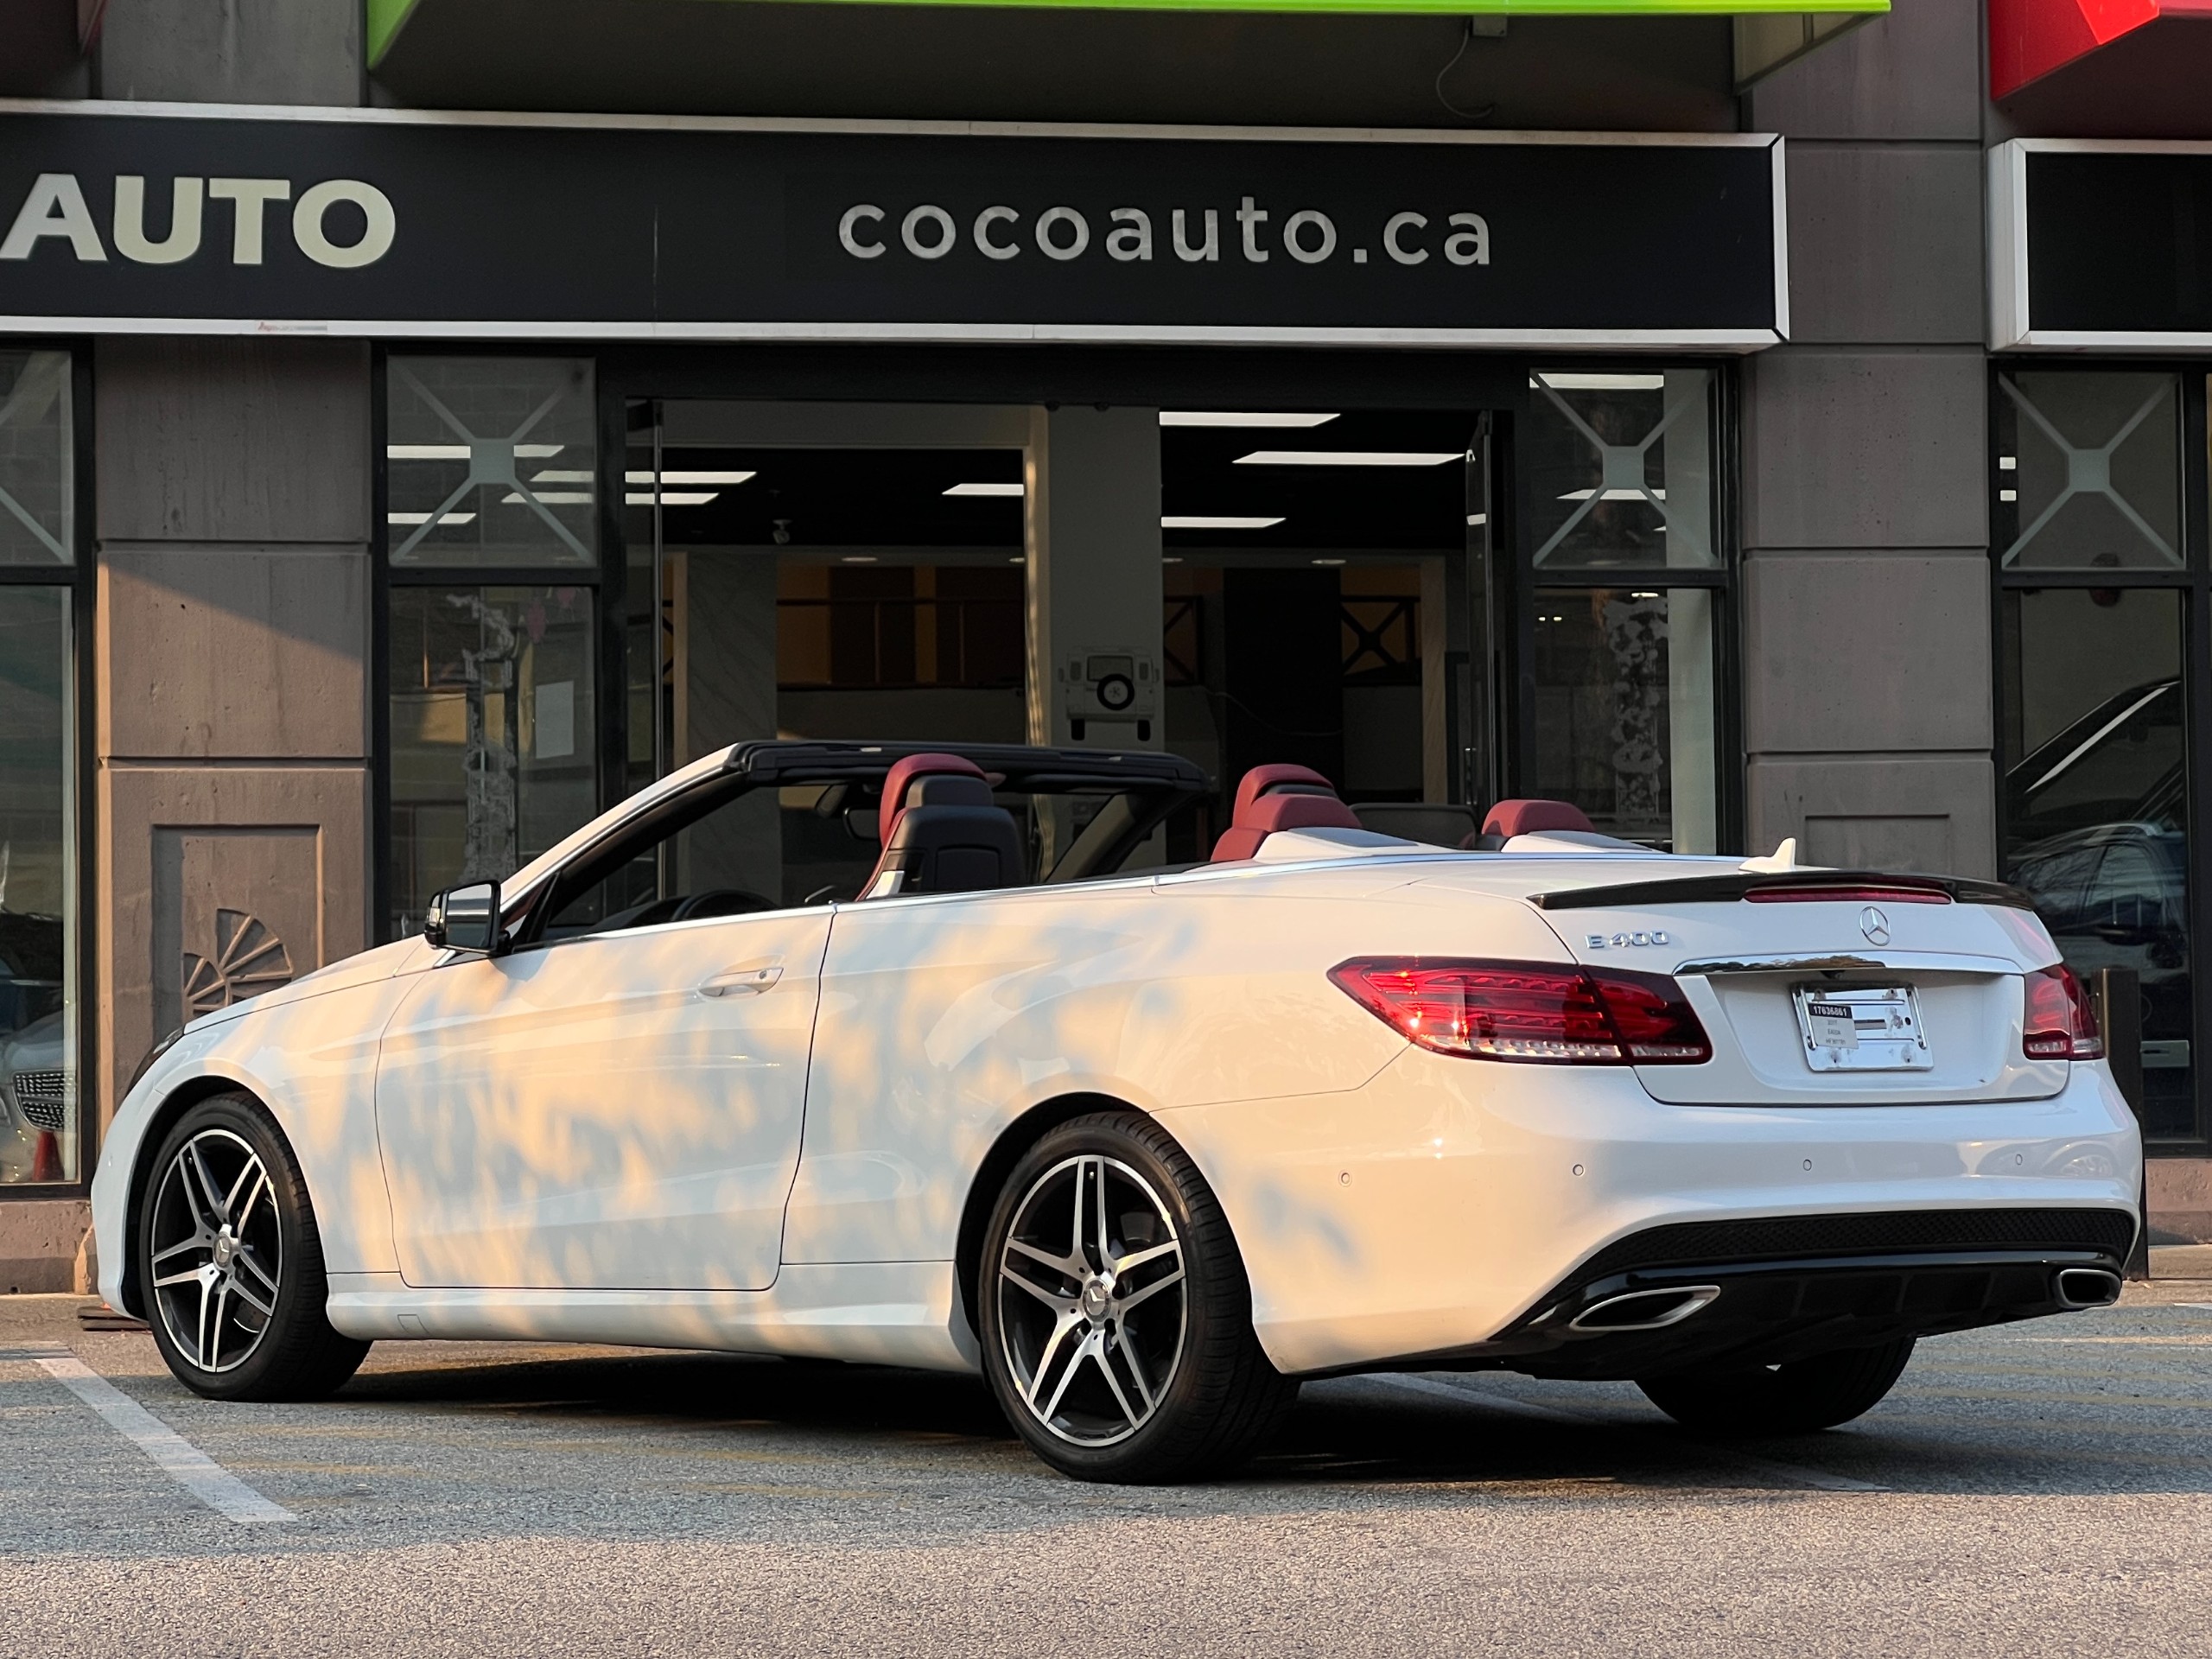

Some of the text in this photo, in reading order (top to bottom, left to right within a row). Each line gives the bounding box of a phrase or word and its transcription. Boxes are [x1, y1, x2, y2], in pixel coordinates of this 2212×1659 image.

[0, 173, 396, 268] AUTO
[838, 195, 1491, 266] cocoauto.ca
[1585, 930, 1669, 949] E 400
